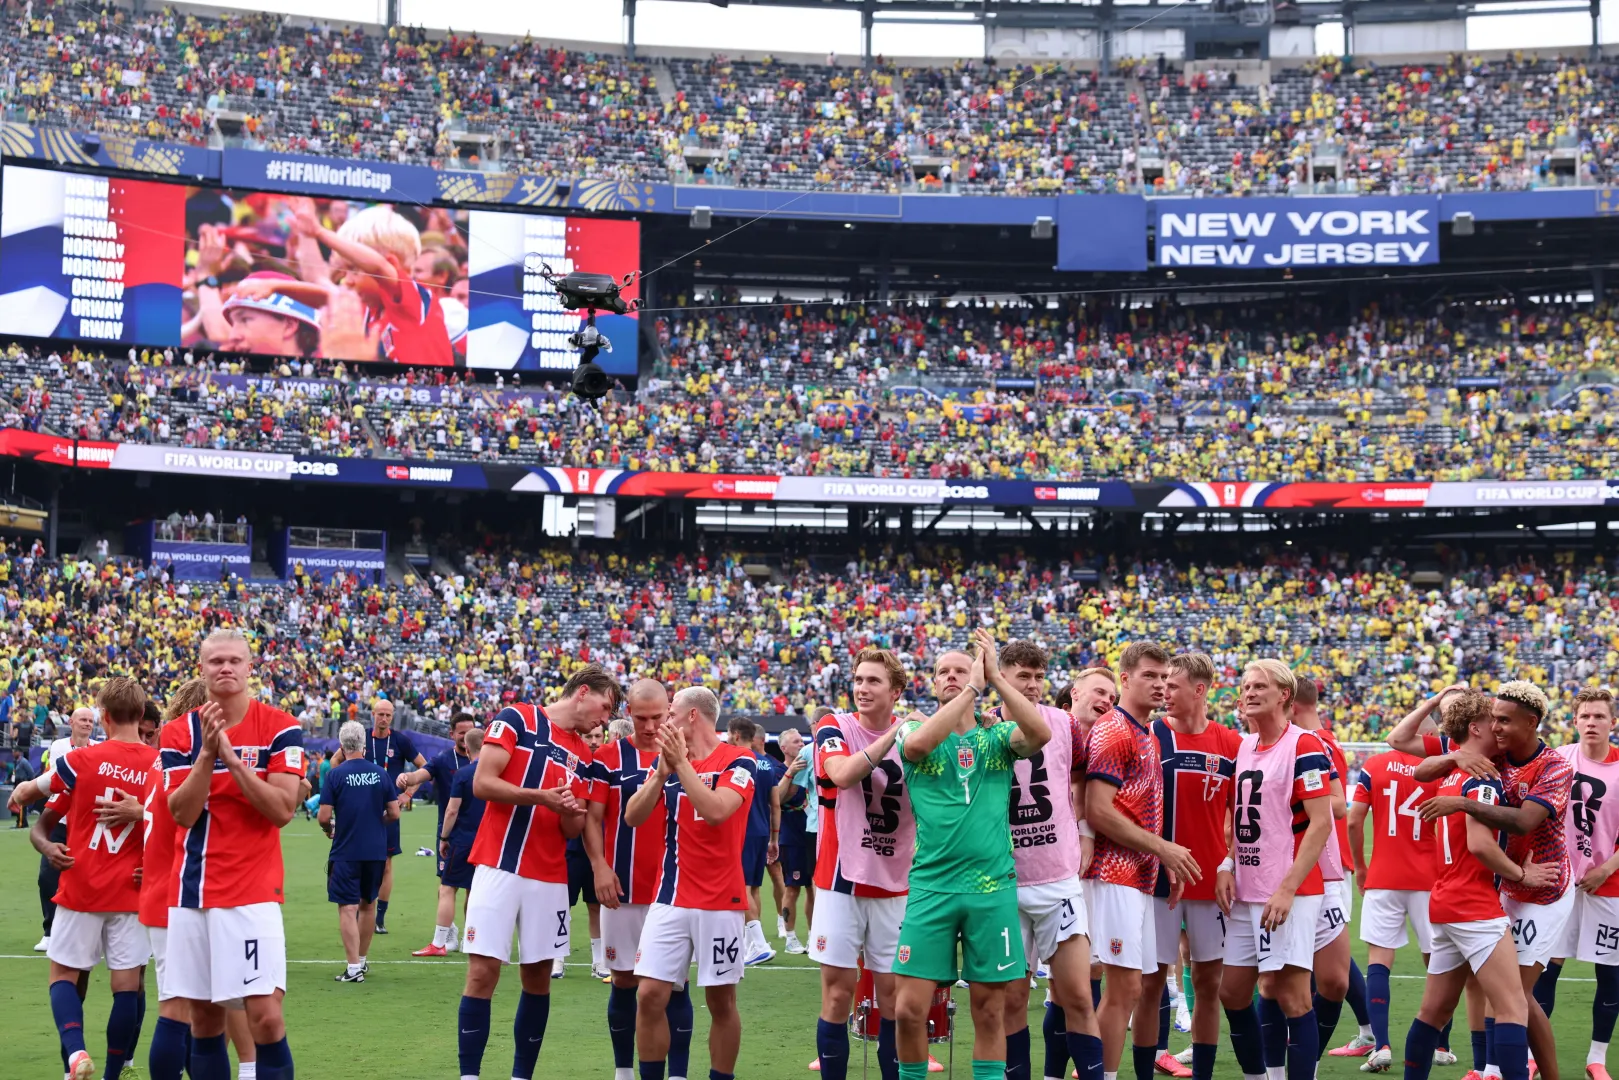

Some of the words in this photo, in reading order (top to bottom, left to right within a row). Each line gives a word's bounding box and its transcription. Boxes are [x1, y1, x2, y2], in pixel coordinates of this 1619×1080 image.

[265, 160, 391, 193] #FIFAWorldCup
[1161, 213, 1276, 237] NEW
[1287, 210, 1430, 236] YORK
[62, 236, 125, 259] NORWAY
[1161, 245, 1256, 265] NEW
[1263, 242, 1430, 265] JERSEY
[62, 256, 125, 280] NORWAY
[71, 277, 125, 300] ORWAY
[70, 297, 124, 320] ORWAY
[80, 318, 124, 340] RWAY
[532, 312, 581, 331] ORWAY
[540, 351, 581, 370] RWAY
[164, 452, 197, 467] FIFA
[198, 456, 252, 471] WORLD
[254, 459, 284, 473] CUP
[286, 461, 339, 476] 2026
[409, 466, 453, 482] NORWAY
[735, 481, 778, 494] NORWAY
[823, 483, 854, 496] FIFA
[855, 484, 907, 497] WORLD
[908, 485, 936, 498] CUP
[938, 486, 989, 499] 2026
[1057, 487, 1100, 501] NORWAY
[1384, 488, 1429, 501] NORWAY
[1475, 488, 1507, 500] FIFA
[1509, 487, 1564, 500] WORLD
[1566, 486, 1598, 499] CUP
[151, 551, 171, 560] FIFA
[171, 552, 202, 562] WORLD
[203, 554, 220, 563] CUP
[306, 558, 337, 567] WORLD
[338, 559, 355, 568] CUP
[355, 560, 385, 569] 2026
[961, 778, 971, 805] 1
[1202, 775, 1223, 802] 17
[1017, 808, 1041, 819] FIFA
[1382, 780, 1424, 841] 14
[1039, 824, 1056, 834] CUP
[1239, 828, 1252, 837] FIFA
[878, 837, 896, 845] CUP
[556, 910, 568, 937] 8
[1323, 907, 1346, 930] 19
[1000, 927, 1010, 957] 1
[1595, 923, 1619, 950] 23
[244, 939, 259, 971] 9
[713, 937, 739, 965] 26
